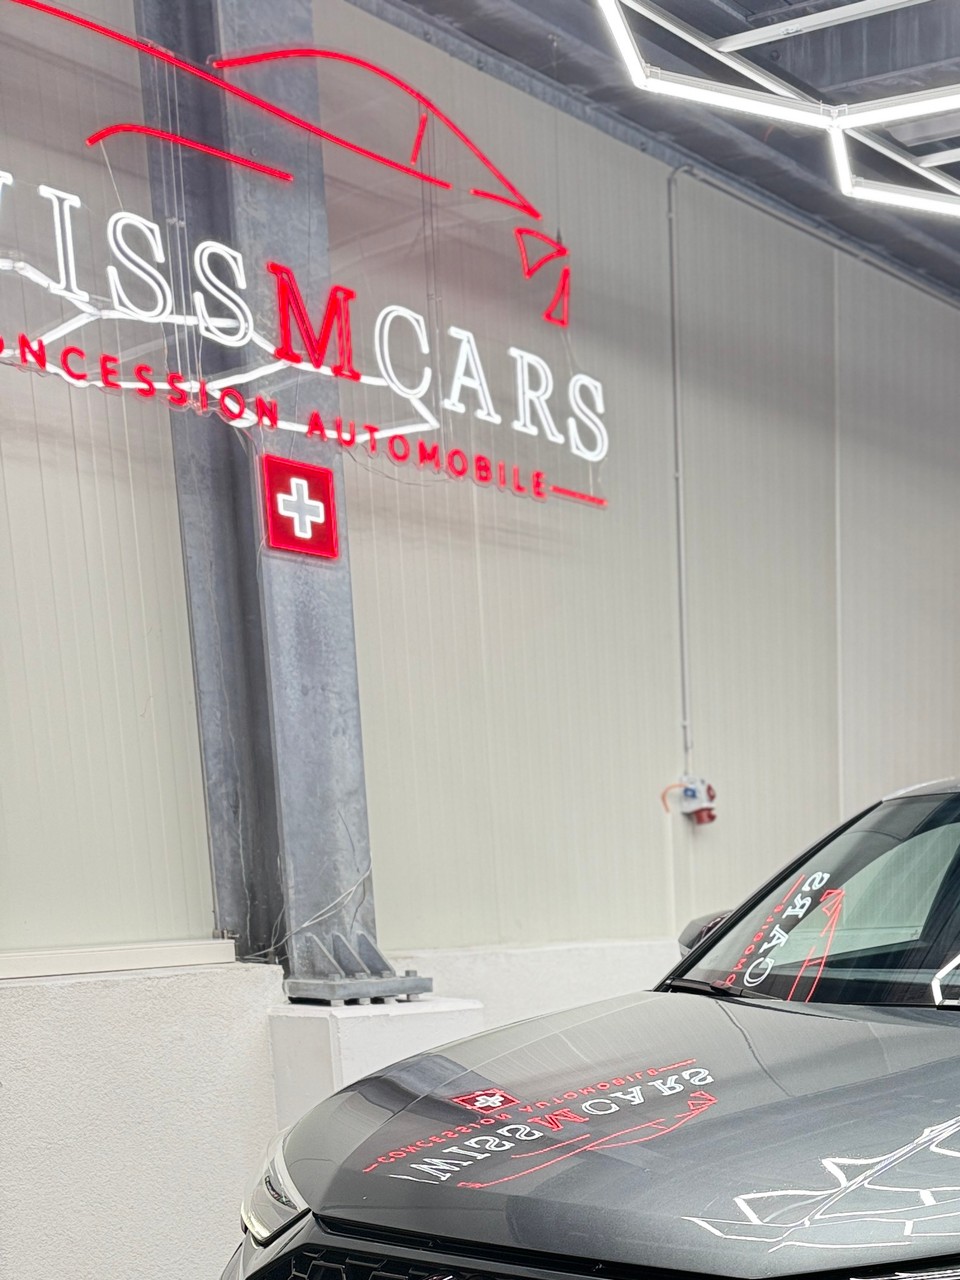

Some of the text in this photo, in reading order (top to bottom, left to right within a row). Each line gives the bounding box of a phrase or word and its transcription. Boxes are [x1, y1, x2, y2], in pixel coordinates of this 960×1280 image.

[0, 171, 609, 462] ISSMCARS
[0, 333, 547, 499] NCESSION AUTOMOBILE
